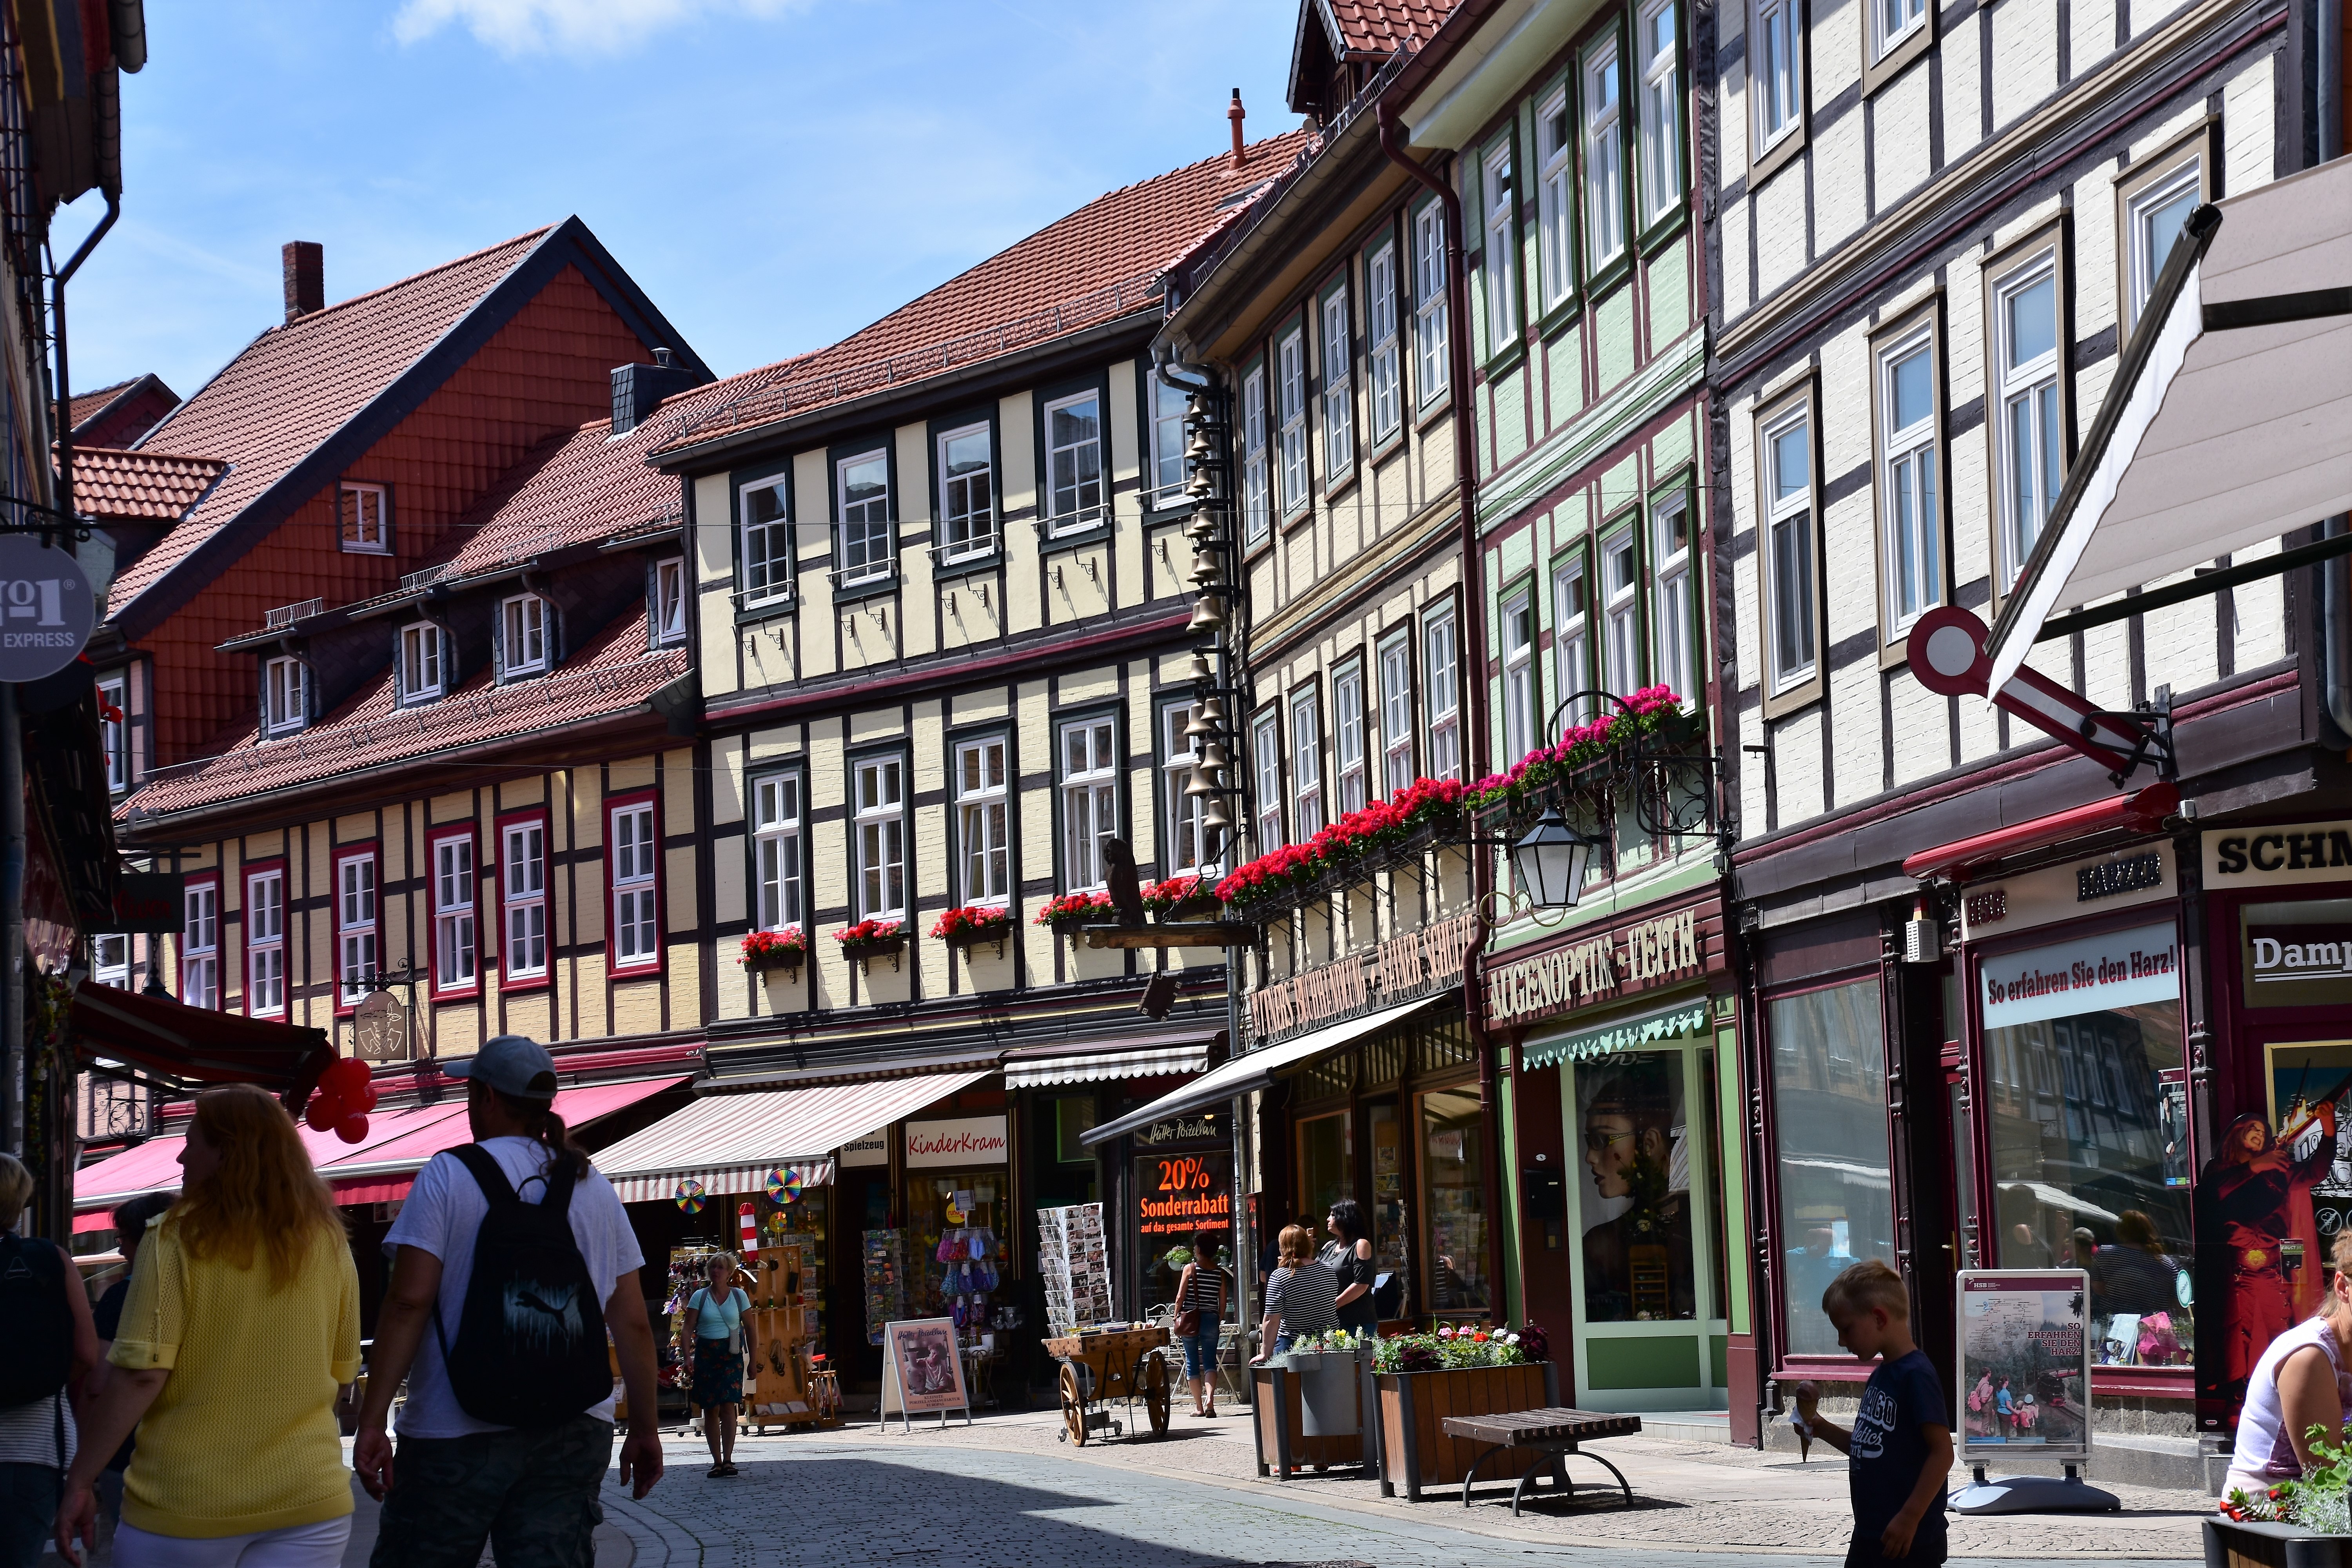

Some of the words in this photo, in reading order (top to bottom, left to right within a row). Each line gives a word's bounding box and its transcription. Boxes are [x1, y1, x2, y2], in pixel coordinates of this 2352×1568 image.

[4, 632, 75, 647] EXPRESS
[1966, 890, 2006, 927] HSB
[2076, 853, 2162, 902] HARZER
[1293, 955, 1367, 1024] BUCHHANDLUNG
[1377, 933, 1422, 995] RAINER
[1424, 913, 1474, 979] SCHULZE
[1490, 935, 1614, 1022] AUGENOPTIK
[1627, 909, 1698, 982] VEITH
[1989, 979, 2004, 1005] So
[2008, 969, 2069, 1001] erfahren
[2072, 961, 2094, 989] Sie
[2098, 957, 2127, 984] den
[2130, 945, 2175, 979] Harz!
[908, 1132, 1005, 1156] KinderKram
[1149, 1123, 1174, 1144] Hütter
[1177, 1119, 1216, 1140] Porzellan
[844, 1140, 884, 1152] Spielzeug
[1158, 1156, 1210, 1191] 20%
[1141, 1193, 1229, 1218] Sonderrabatt
[1141, 1223, 1152, 1233] auf
[1154, 1221, 1165, 1232] das
[1166, 1220, 1193, 1234] gesamte
[1195, 1219, 1229, 1230] Sortiment
